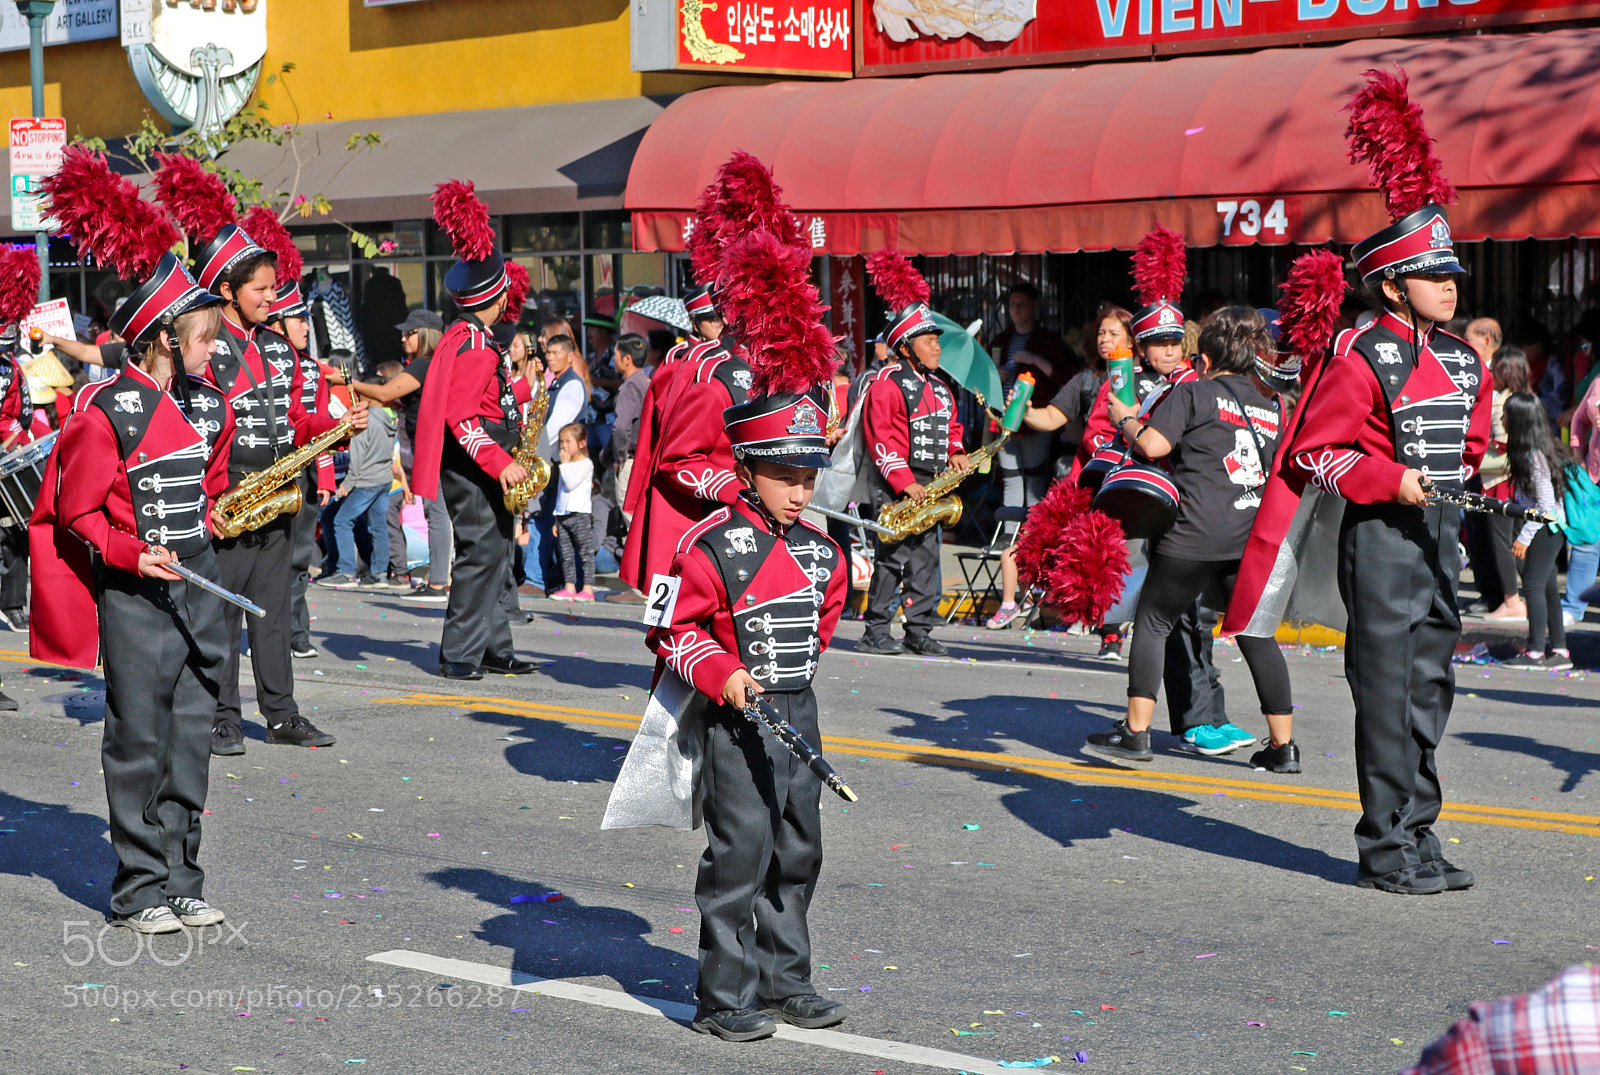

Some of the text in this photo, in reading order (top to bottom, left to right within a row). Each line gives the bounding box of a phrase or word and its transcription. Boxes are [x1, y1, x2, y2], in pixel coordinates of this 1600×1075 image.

[57, 8, 113, 29] ART GALLERY
[11, 131, 63, 146] NO STOPPING
[1216, 199, 1289, 236] 734
[651, 582, 670, 612] 2
